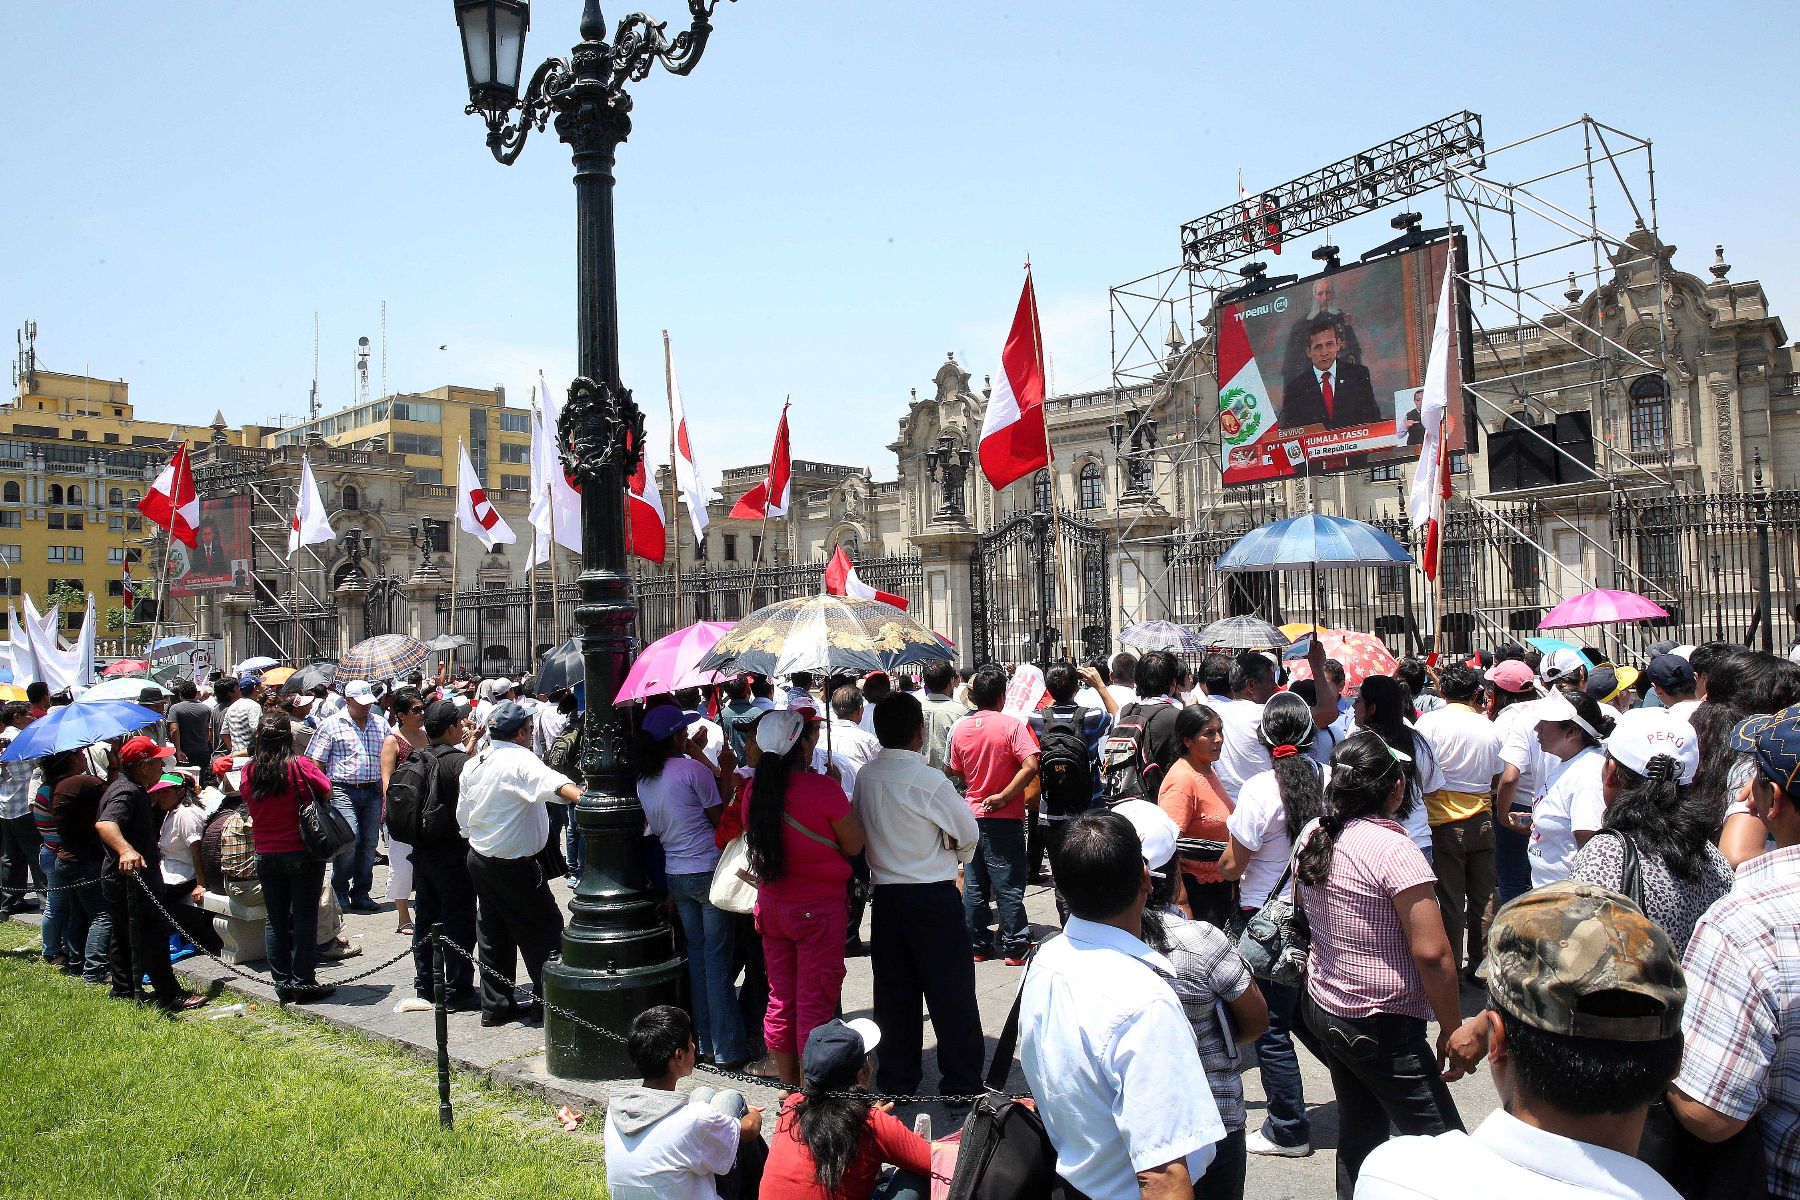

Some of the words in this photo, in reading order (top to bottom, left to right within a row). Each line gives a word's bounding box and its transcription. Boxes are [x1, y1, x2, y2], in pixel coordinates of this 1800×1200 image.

[1288, 428, 1304, 436] VIVO
[1306, 434, 1339, 445] HUMALA
[1341, 429, 1368, 439] TASSO
[1315, 447, 1320, 455] la
[1323, 443, 1357, 453] República
